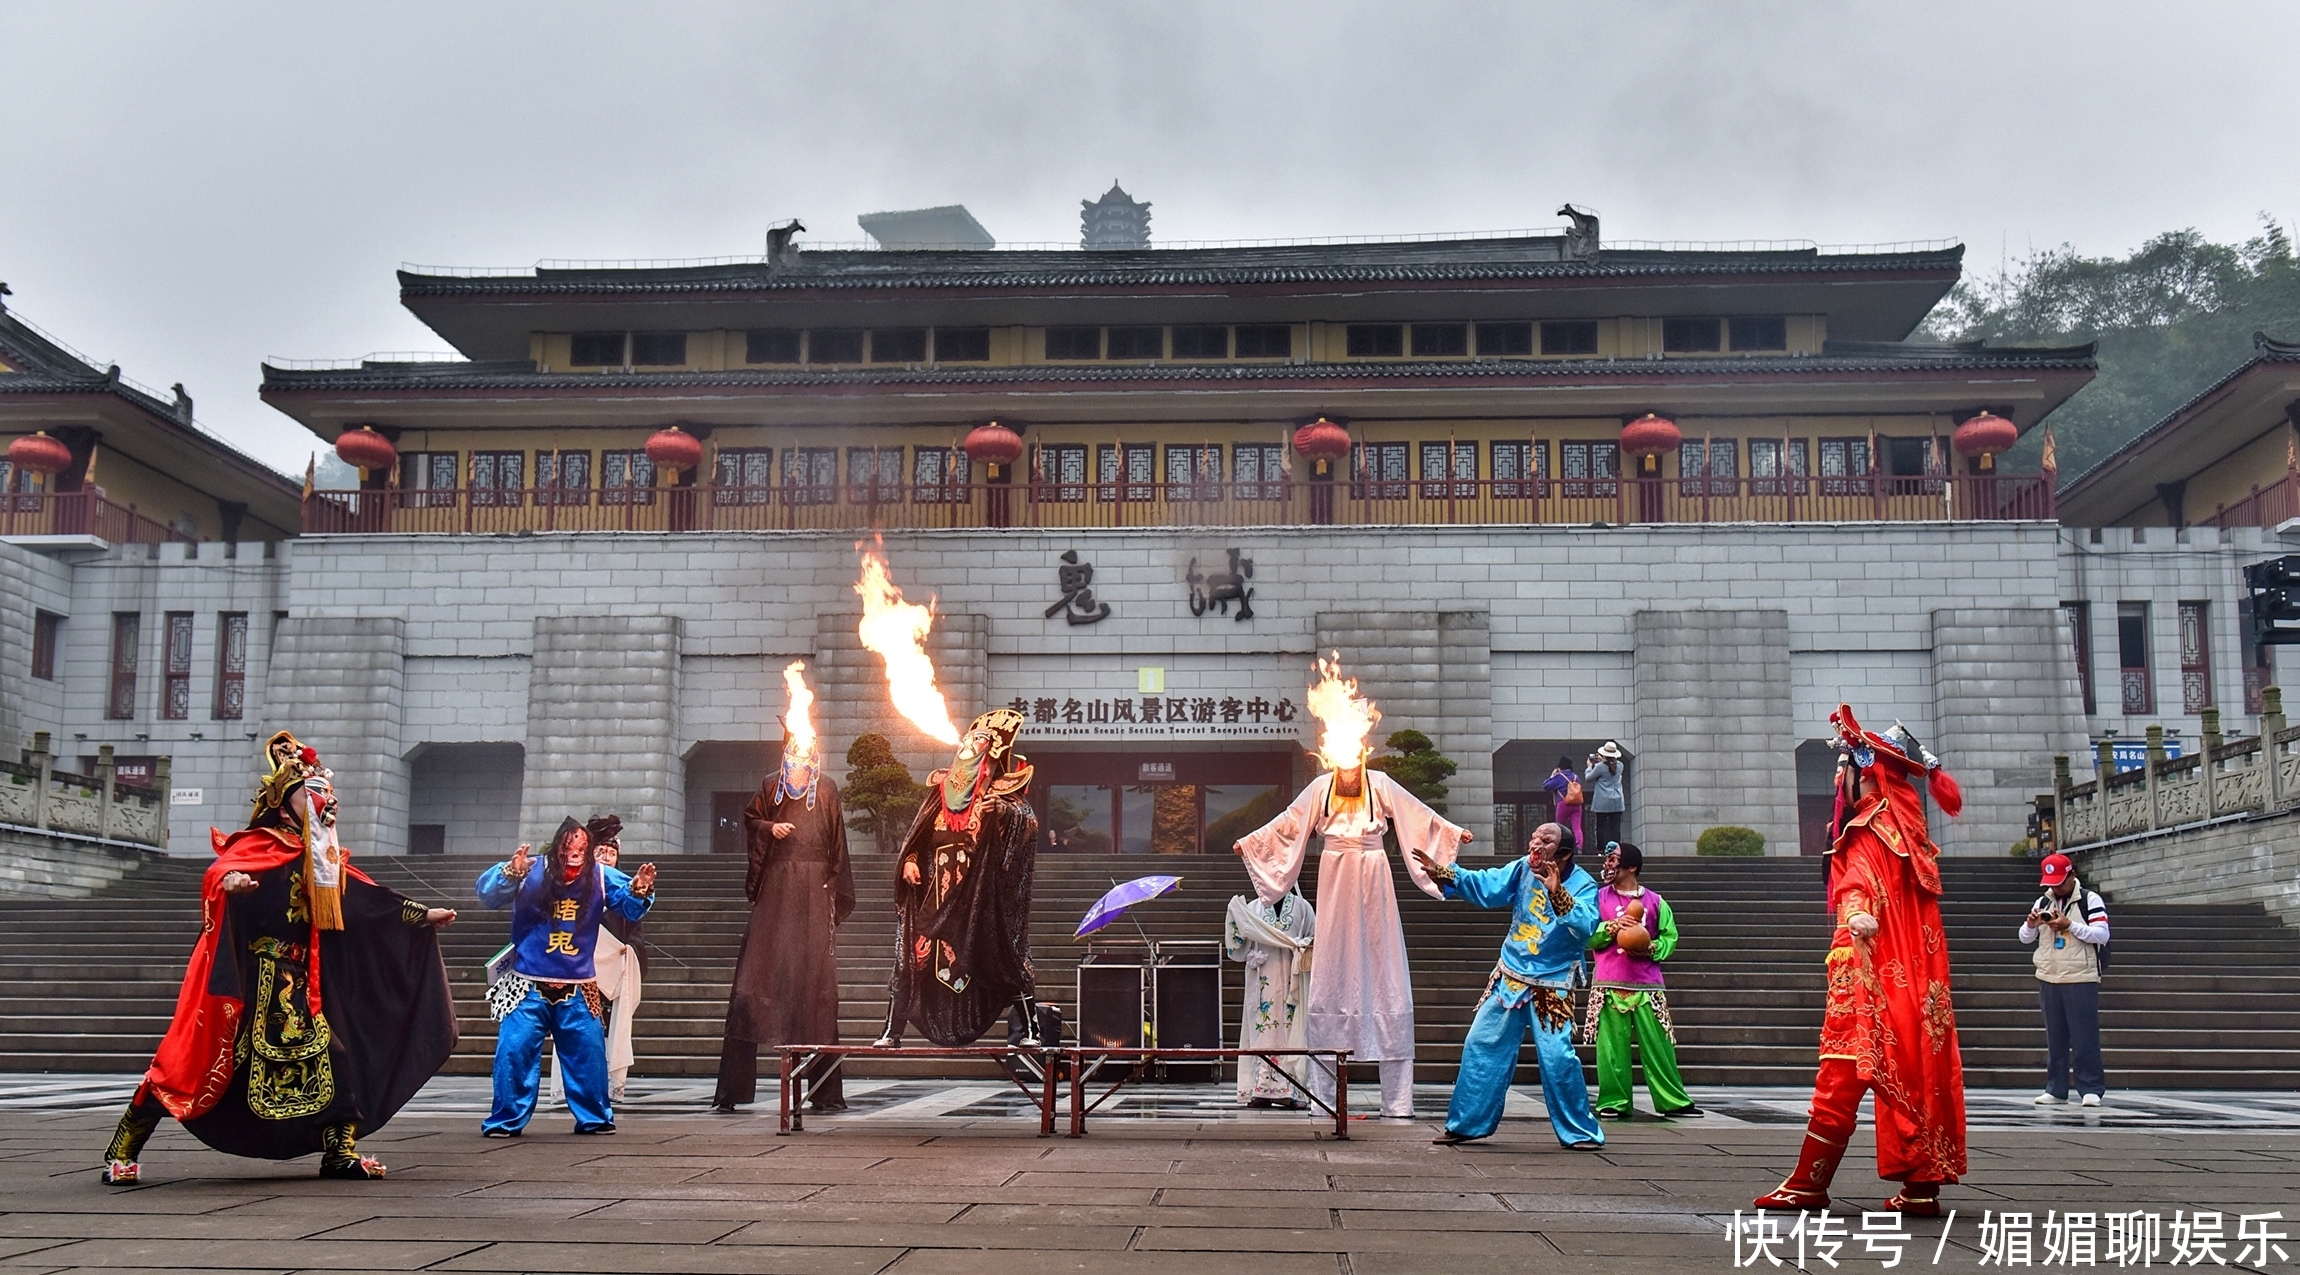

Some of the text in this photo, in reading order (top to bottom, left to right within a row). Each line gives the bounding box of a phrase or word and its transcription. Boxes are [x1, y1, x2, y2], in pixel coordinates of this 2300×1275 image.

[1019, 727, 1042, 735] ngdu
[1045, 727, 1090, 735] Mingshan
[1169, 726, 1205, 734] Tourist
[1210, 726, 1259, 735] Reception
[117, 766, 146, 775] 团队通道
